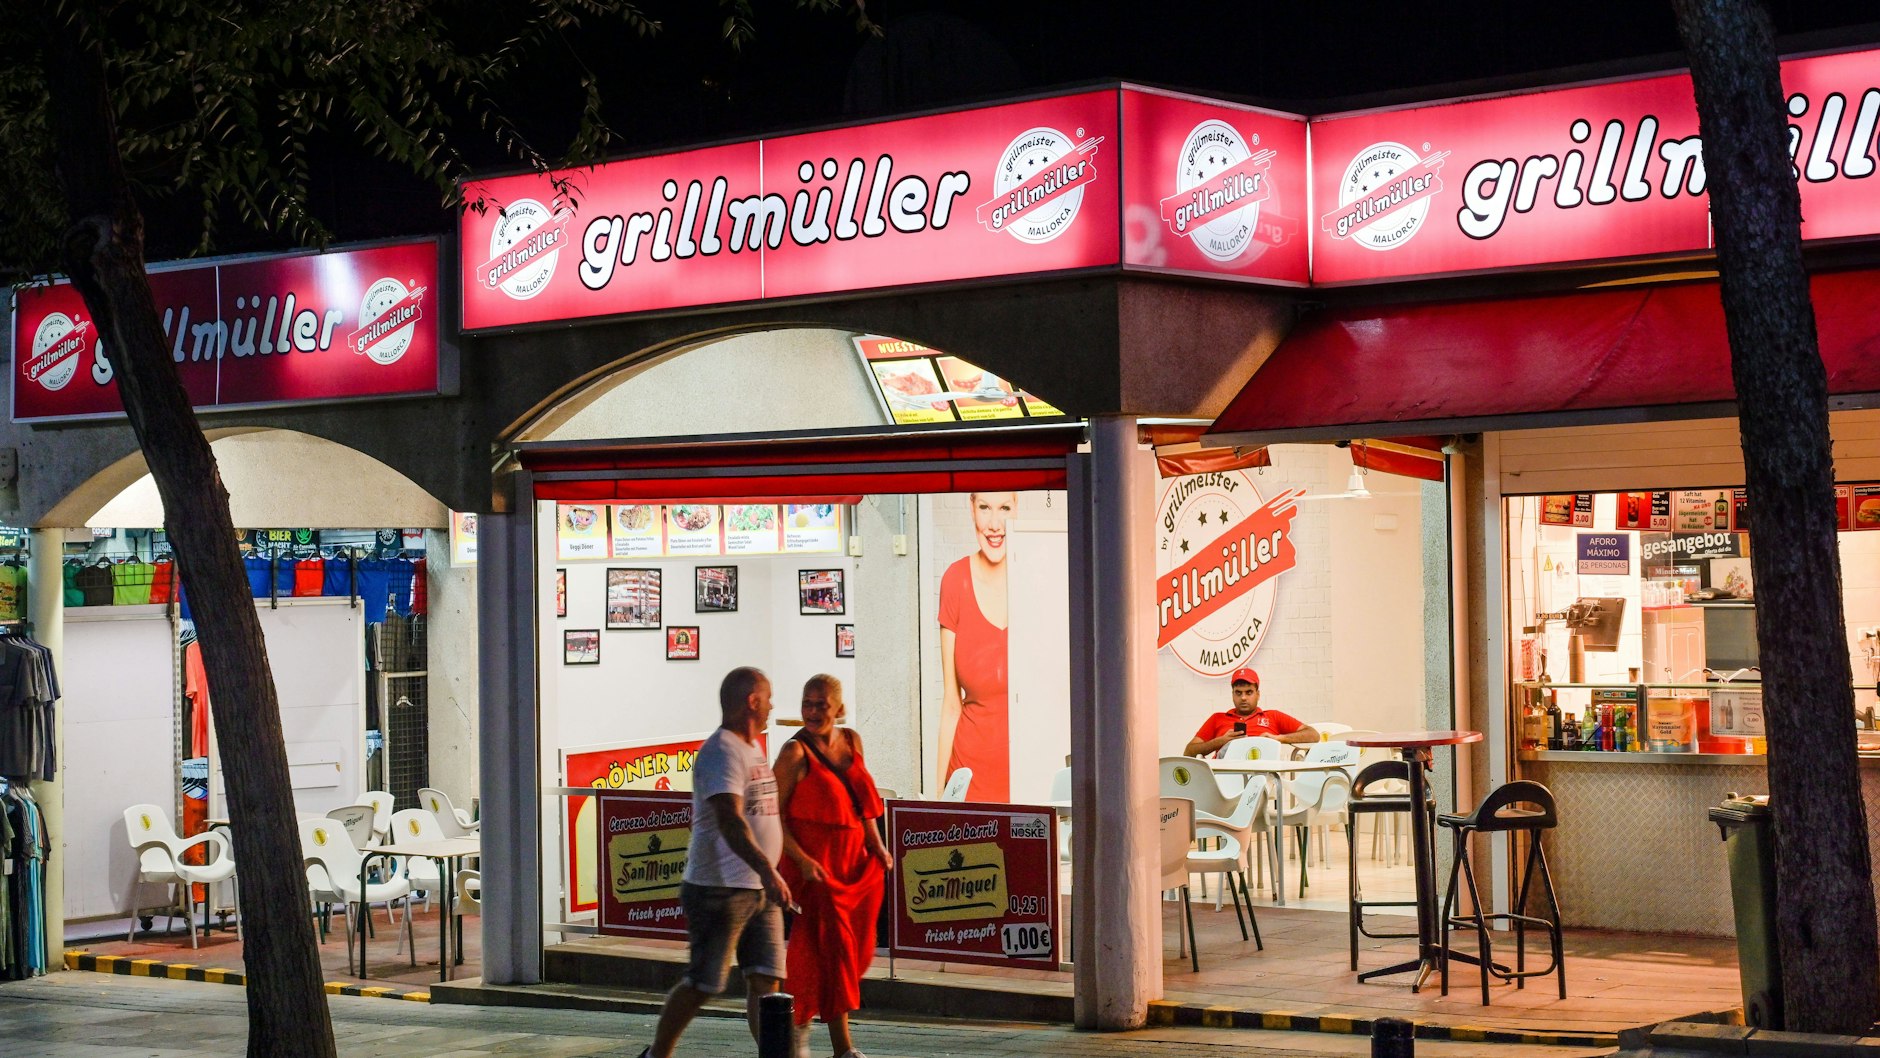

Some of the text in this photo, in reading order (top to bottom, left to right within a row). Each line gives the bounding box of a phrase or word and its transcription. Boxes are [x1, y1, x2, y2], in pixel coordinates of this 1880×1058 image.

[1006, 136, 1056, 173] grillmeister
[1188, 130, 1234, 165] grillmeister
[1350, 150, 1402, 184] grillmeister
[992, 160, 1087, 229] grillmüller
[1175, 172, 1261, 232] grillmüller
[1336, 172, 1433, 237] grillmüller
[499, 206, 537, 238] grillmeister
[579, 153, 971, 291] grillmüller
[1028, 207, 1071, 236] MALLORCA
[1373, 216, 1417, 244] MALLORCA
[1209, 224, 1249, 251] MALLORCA
[488, 228, 560, 286] grillmüller
[516, 268, 549, 293] MALLORCA
[358, 304, 416, 352] grillmüller
[30, 336, 80, 379] grillmüller
[379, 338, 406, 358] MALLORCA
[49, 367, 72, 385] MALLORCA
[1164, 471, 1239, 533] grillmeister
[1575, 514, 1589, 523] 3,00
[1653, 518, 1667, 527] 5,00
[268, 530, 292, 541] BIER
[1161, 537, 1169, 550] by
[1589, 537, 1617, 546] AFORO
[1587, 546, 1620, 557] MÁXIMO
[1590, 561, 1627, 569] PERSONAS
[1679, 567, 1697, 575] Maid
[1200, 616, 1262, 668] MALLORCA
[591, 752, 670, 789] DÖNER
[609, 806, 691, 833] Cerveza de barril
[903, 819, 999, 846] Cerveza de barril
[1011, 828, 1045, 838] NOSKE
[628, 906, 653, 921] frisch
[1010, 895, 1038, 916] 0,25
[925, 923, 997, 944] frisch gezapft
